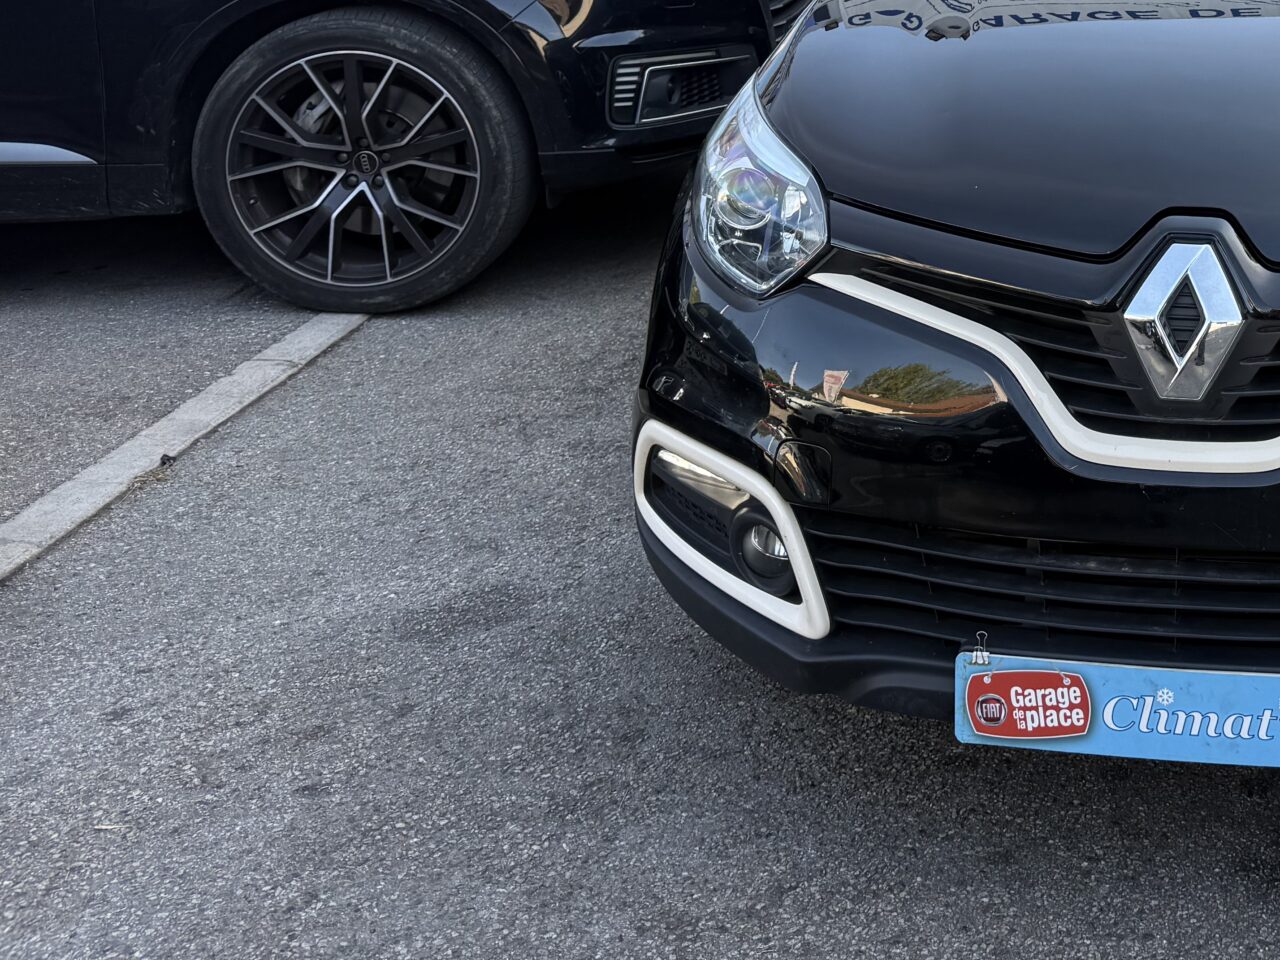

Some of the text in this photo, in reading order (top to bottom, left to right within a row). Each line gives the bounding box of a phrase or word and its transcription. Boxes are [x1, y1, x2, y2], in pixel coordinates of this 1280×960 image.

[1010, 685, 1081, 708] Garage
[982, 703, 1001, 718] FIAT
[1013, 708, 1024, 719] de
[1017, 719, 1026, 729] la
[1026, 706, 1084, 731] place
